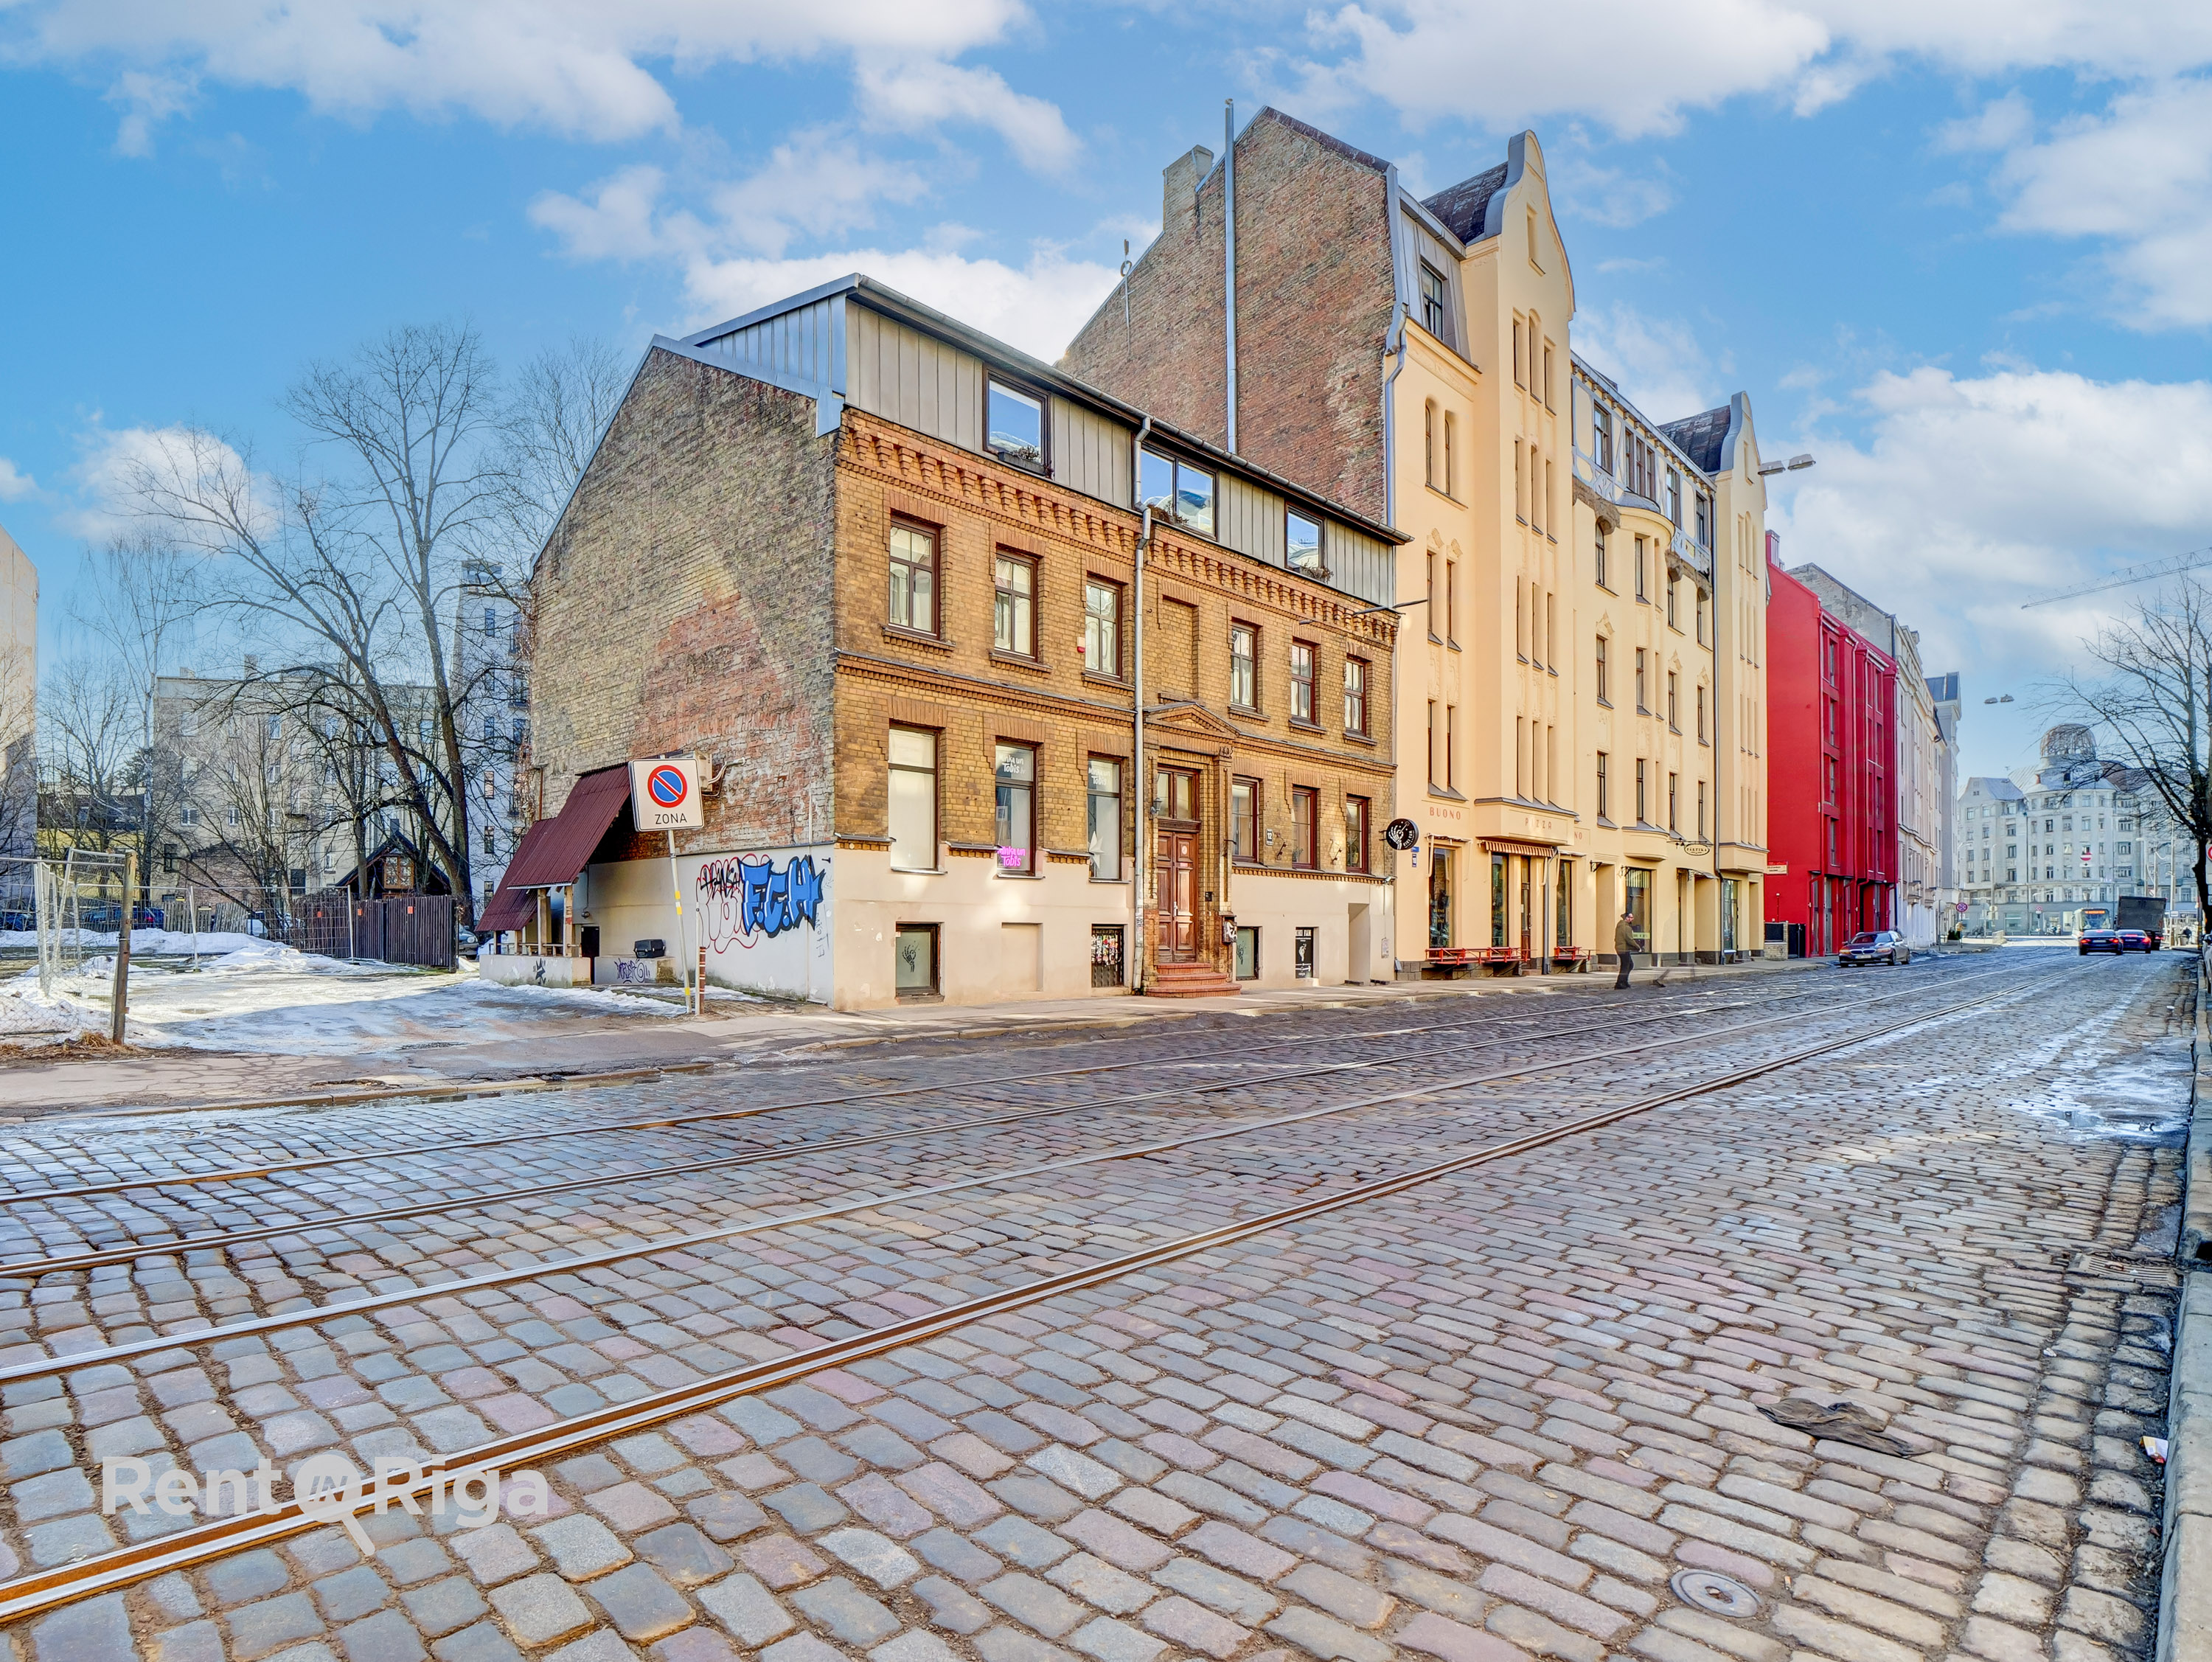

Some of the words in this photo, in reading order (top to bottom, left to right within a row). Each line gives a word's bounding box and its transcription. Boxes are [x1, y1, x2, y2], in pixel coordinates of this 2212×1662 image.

[655, 813, 687, 825] ZONA
[1430, 807, 1461, 820] BUONO
[1525, 818, 1552, 830] PIZZA
[1018, 848, 1026, 856] un
[1001, 855, 1021, 866] Tobis
